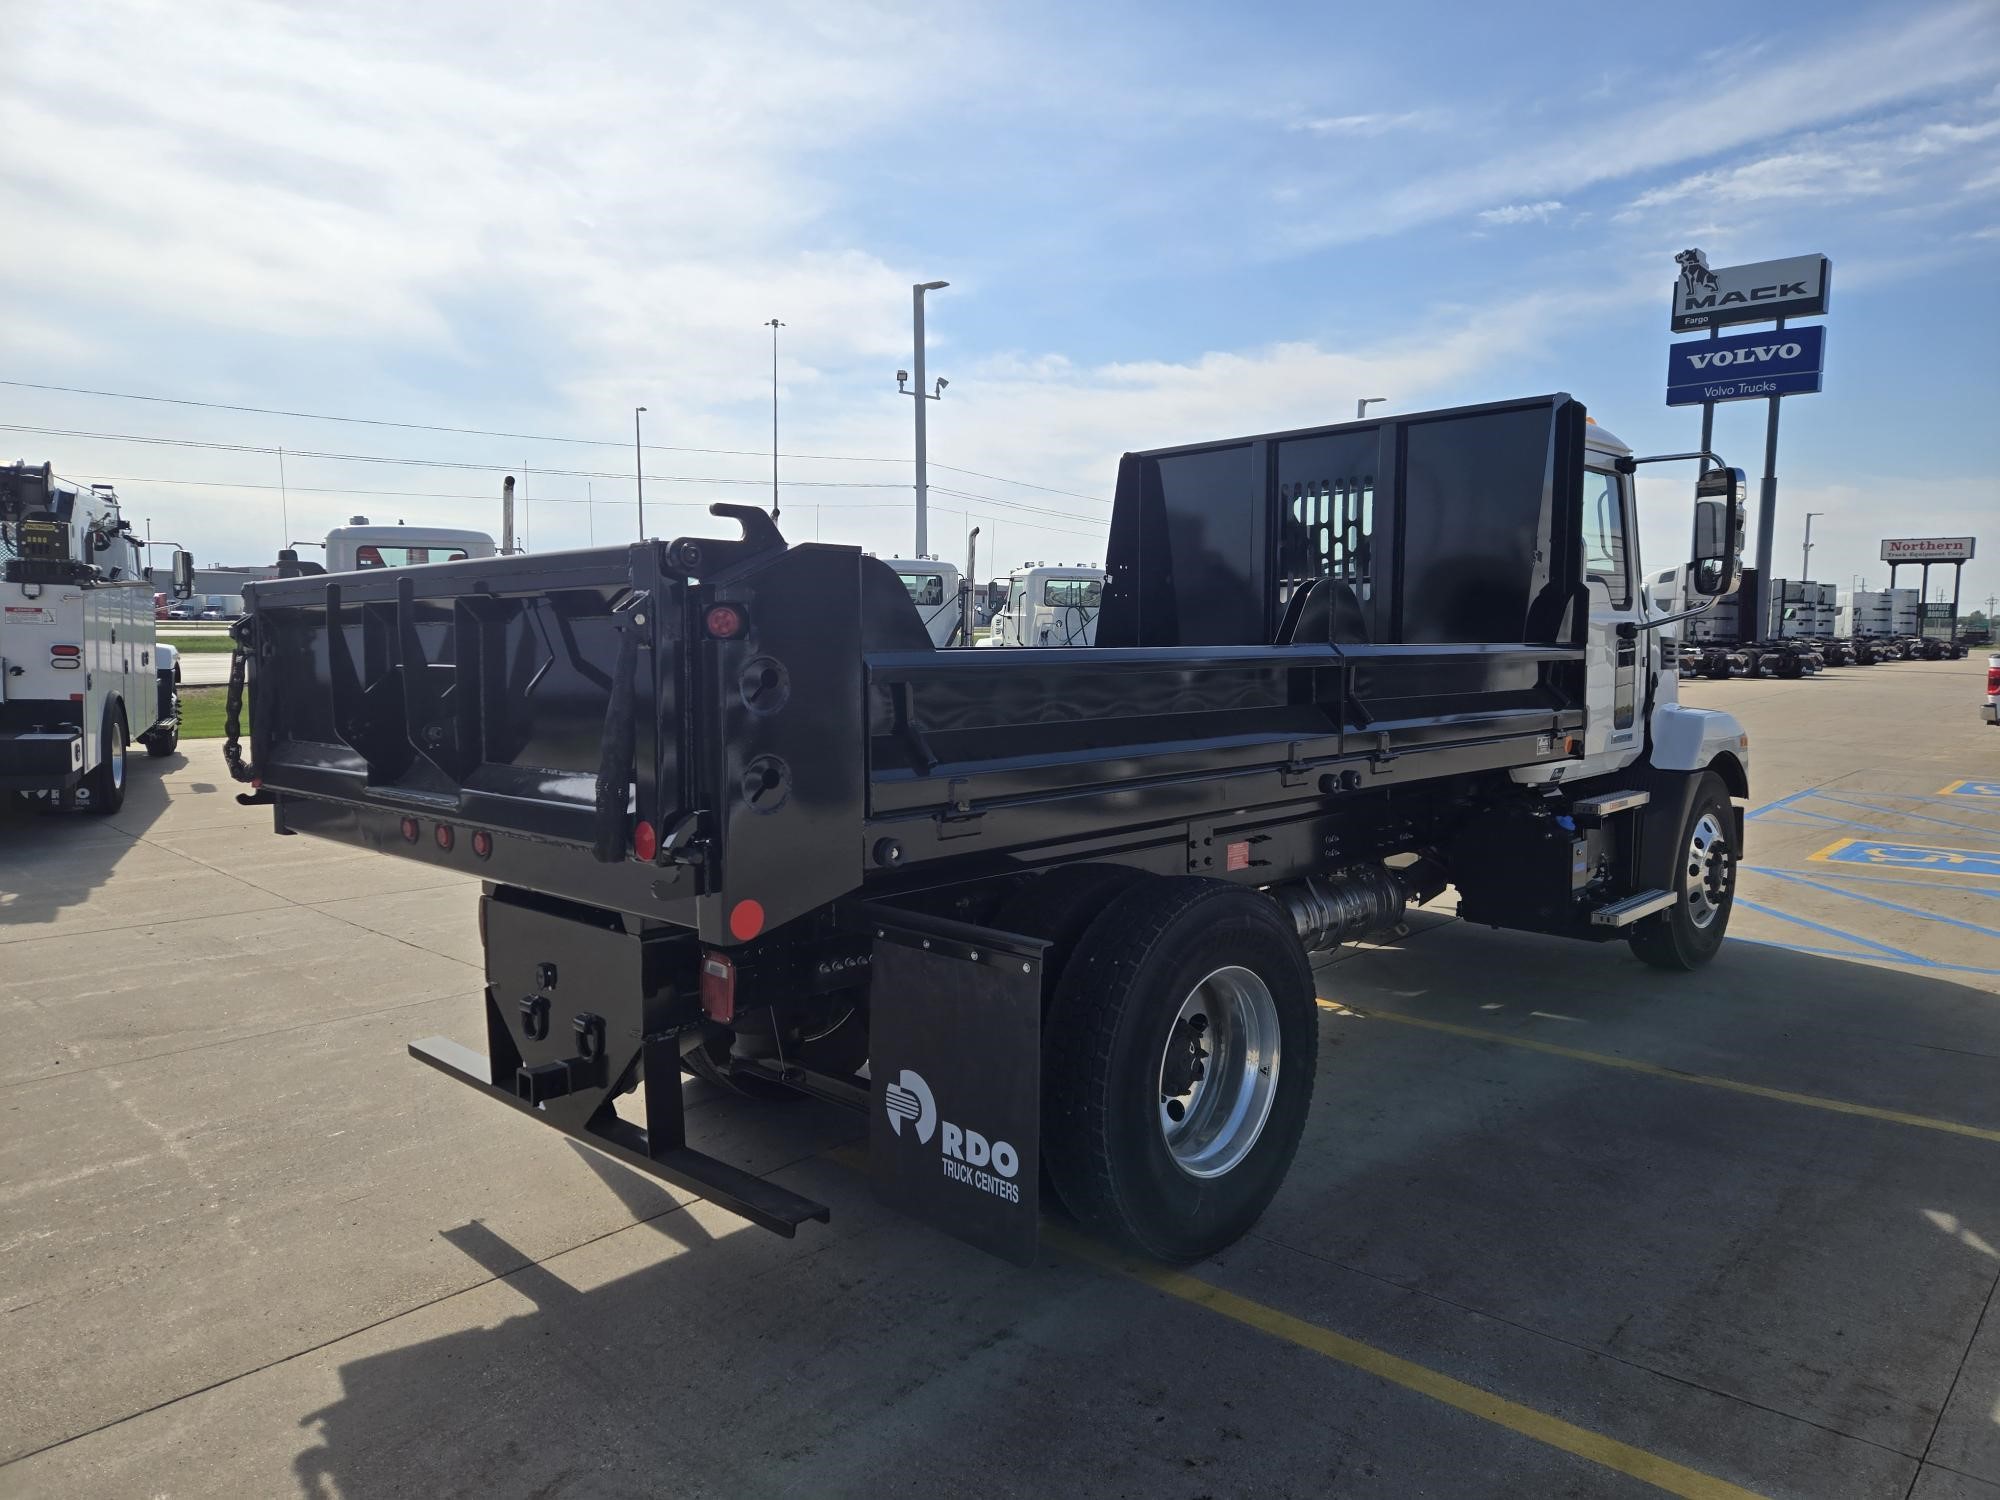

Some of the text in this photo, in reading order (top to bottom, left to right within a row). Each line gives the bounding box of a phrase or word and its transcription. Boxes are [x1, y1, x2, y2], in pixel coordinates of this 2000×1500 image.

[1685, 281, 1808, 310] MACK
[1684, 316, 1709, 325] Fargo
[1686, 342, 1802, 369] VOLVO
[1704, 381, 1777, 397] Volvo Trucks
[1890, 541, 1963, 551] Northern
[942, 1121, 1019, 1178] RDO
[942, 1157, 1019, 1204] TRUCK CENTERS
